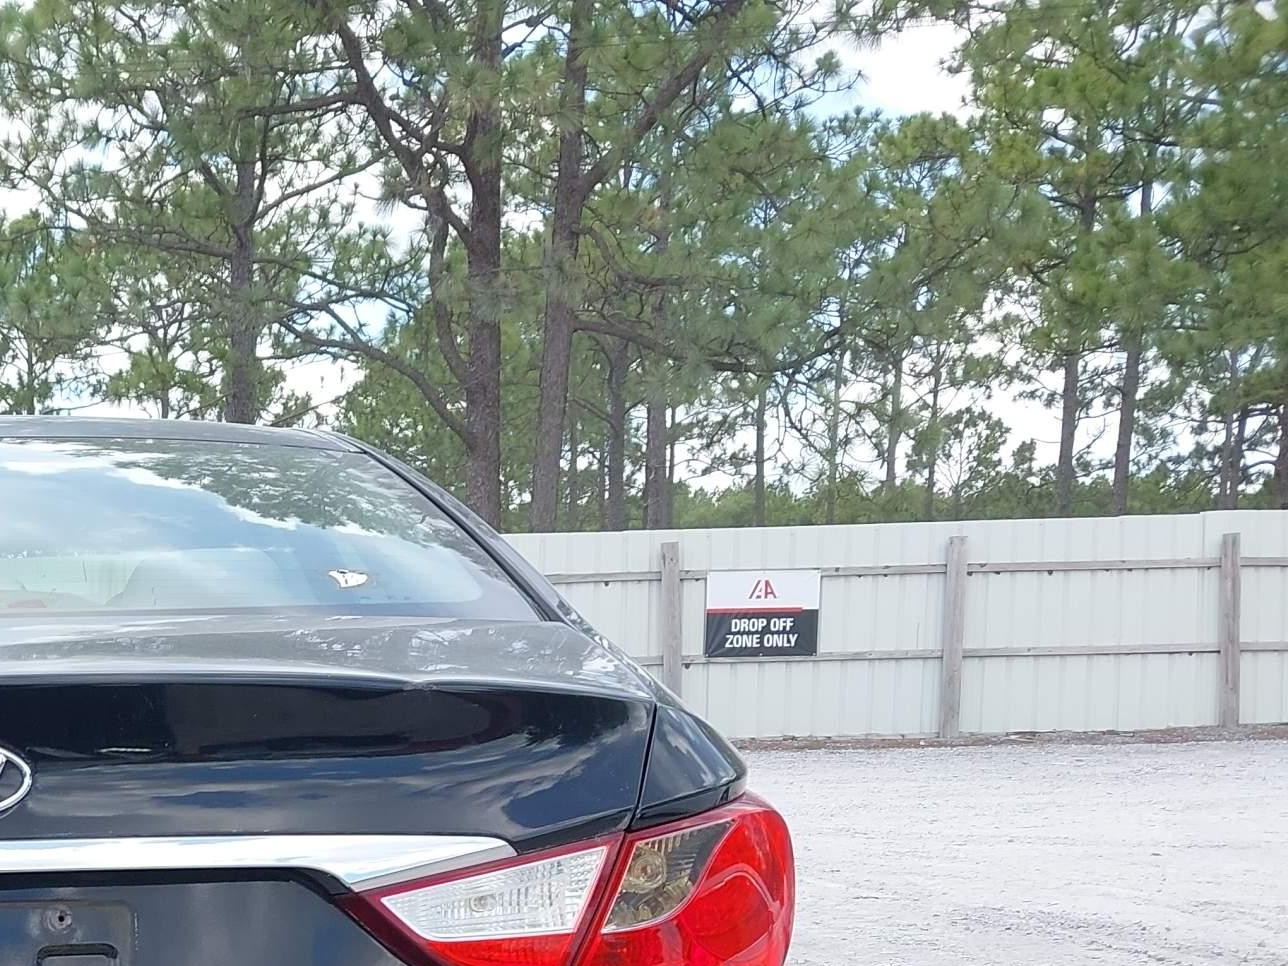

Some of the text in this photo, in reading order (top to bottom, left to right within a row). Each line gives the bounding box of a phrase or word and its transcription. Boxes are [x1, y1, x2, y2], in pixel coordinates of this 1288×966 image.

[731, 617, 794, 632] DROP OFF
[725, 633, 798, 648] ZONE ONLY
